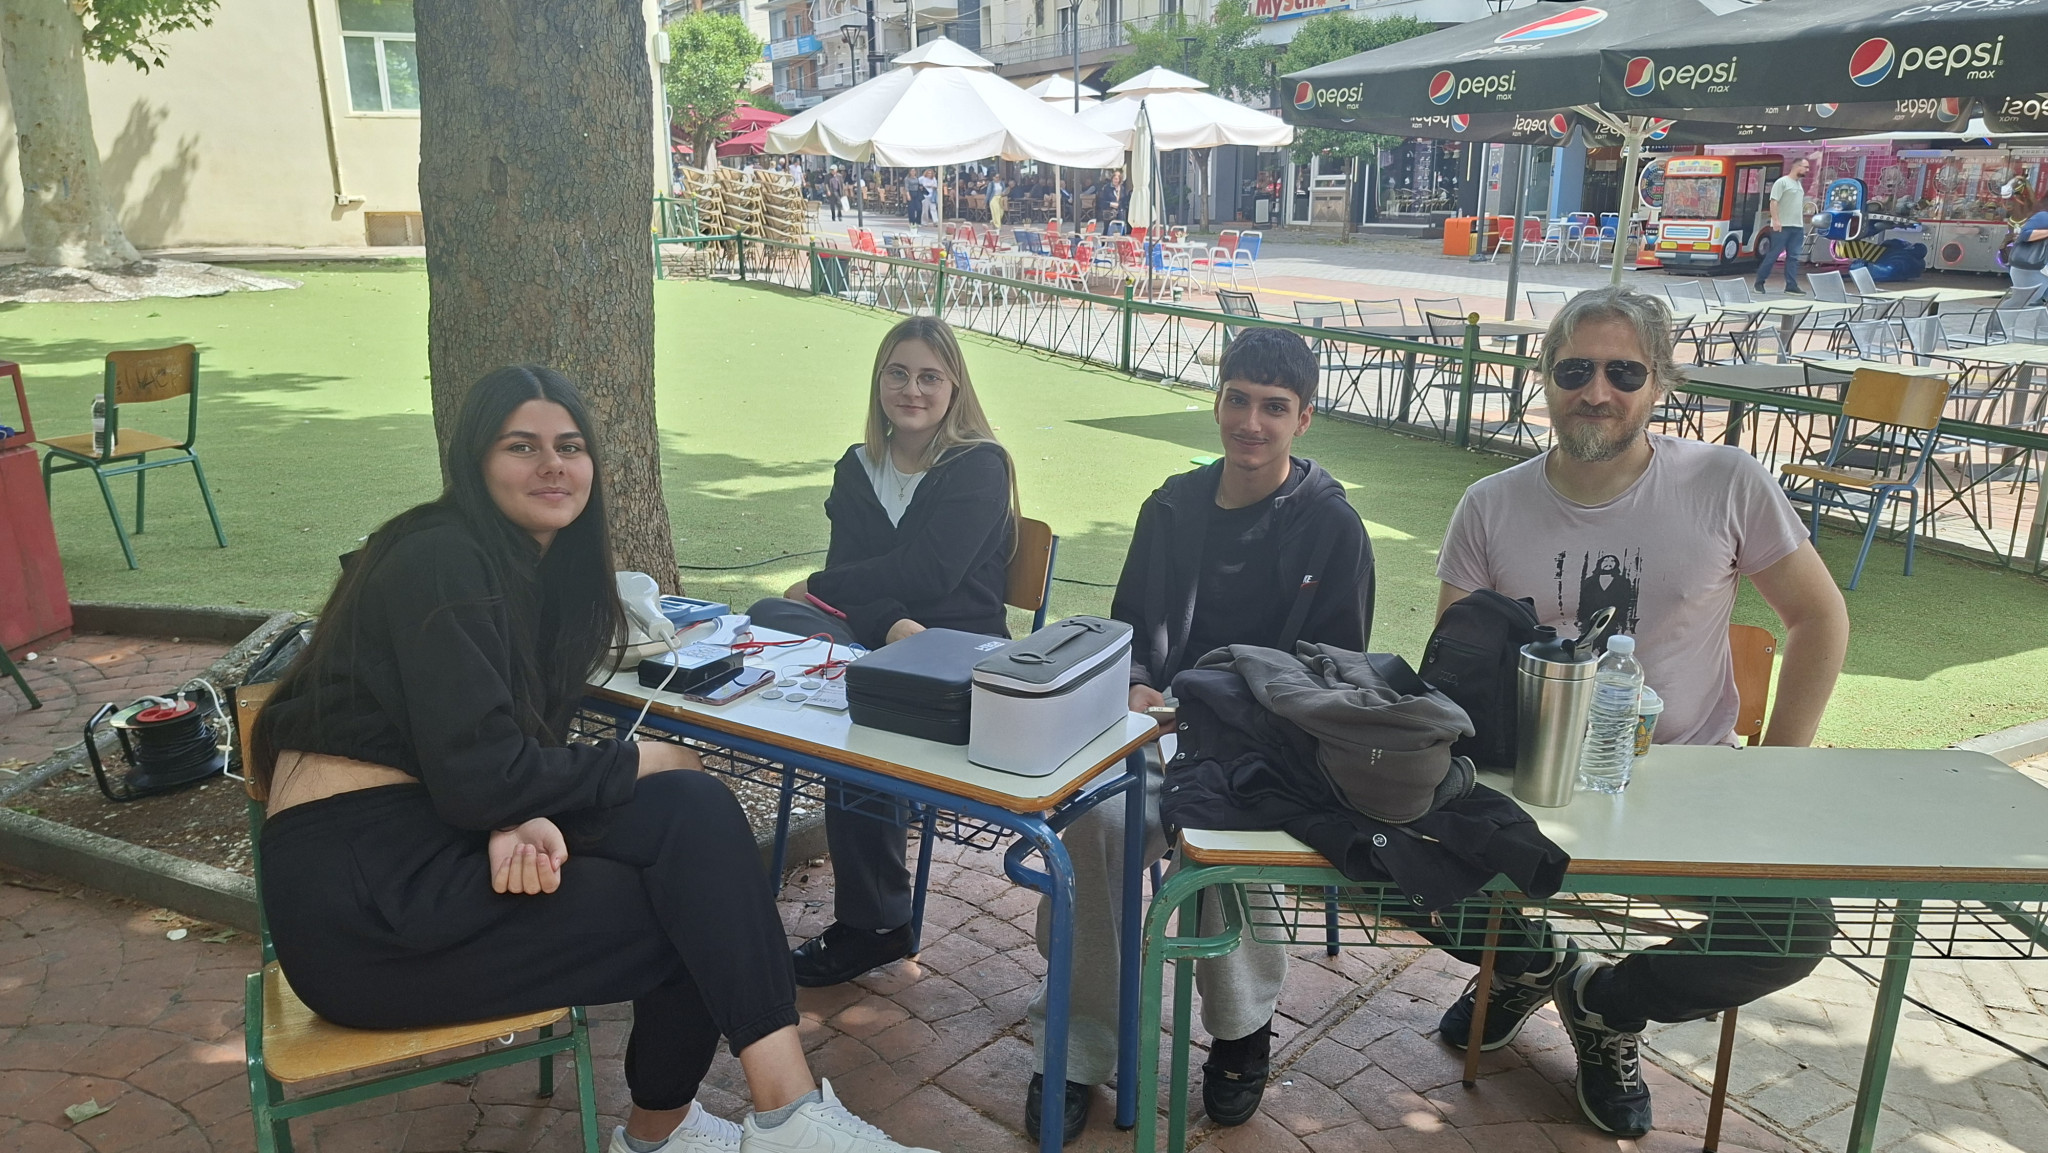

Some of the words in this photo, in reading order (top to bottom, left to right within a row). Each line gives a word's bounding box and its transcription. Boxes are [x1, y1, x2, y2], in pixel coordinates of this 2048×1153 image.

[1897, 35, 2002, 79] pepsi
[1457, 70, 1515, 100] pepsi
[1659, 56, 1737, 90] pepsi
[1966, 69, 1996, 80] max
[1316, 82, 1362, 107] pepsi
[1496, 92, 1512, 101] max
[1707, 83, 1730, 93] max
